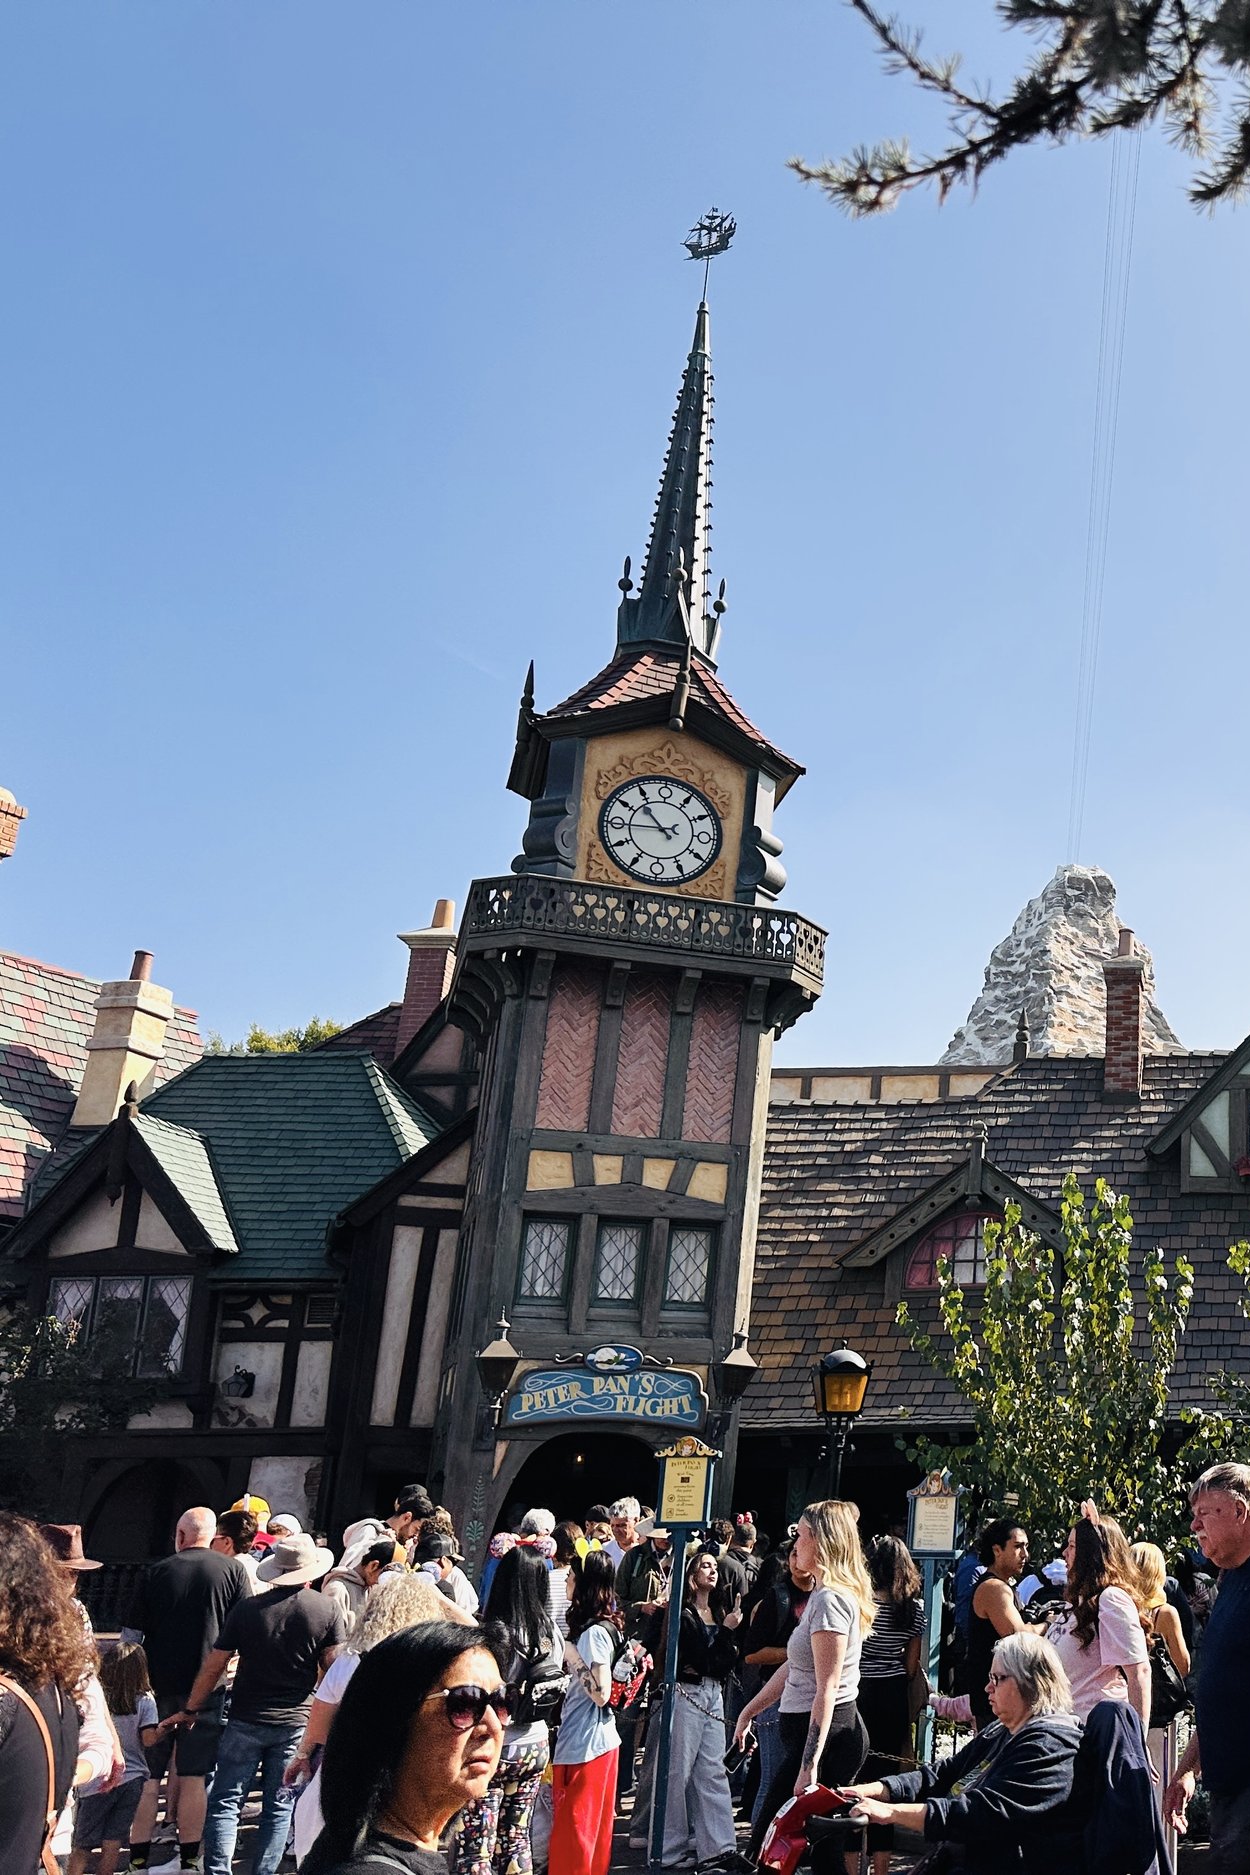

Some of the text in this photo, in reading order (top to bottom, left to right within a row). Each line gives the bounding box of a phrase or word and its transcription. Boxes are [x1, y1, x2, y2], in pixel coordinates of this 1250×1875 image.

[520, 1374, 656, 1413] PETER PAN'S
[614, 1394, 693, 1417] FLIGHT
